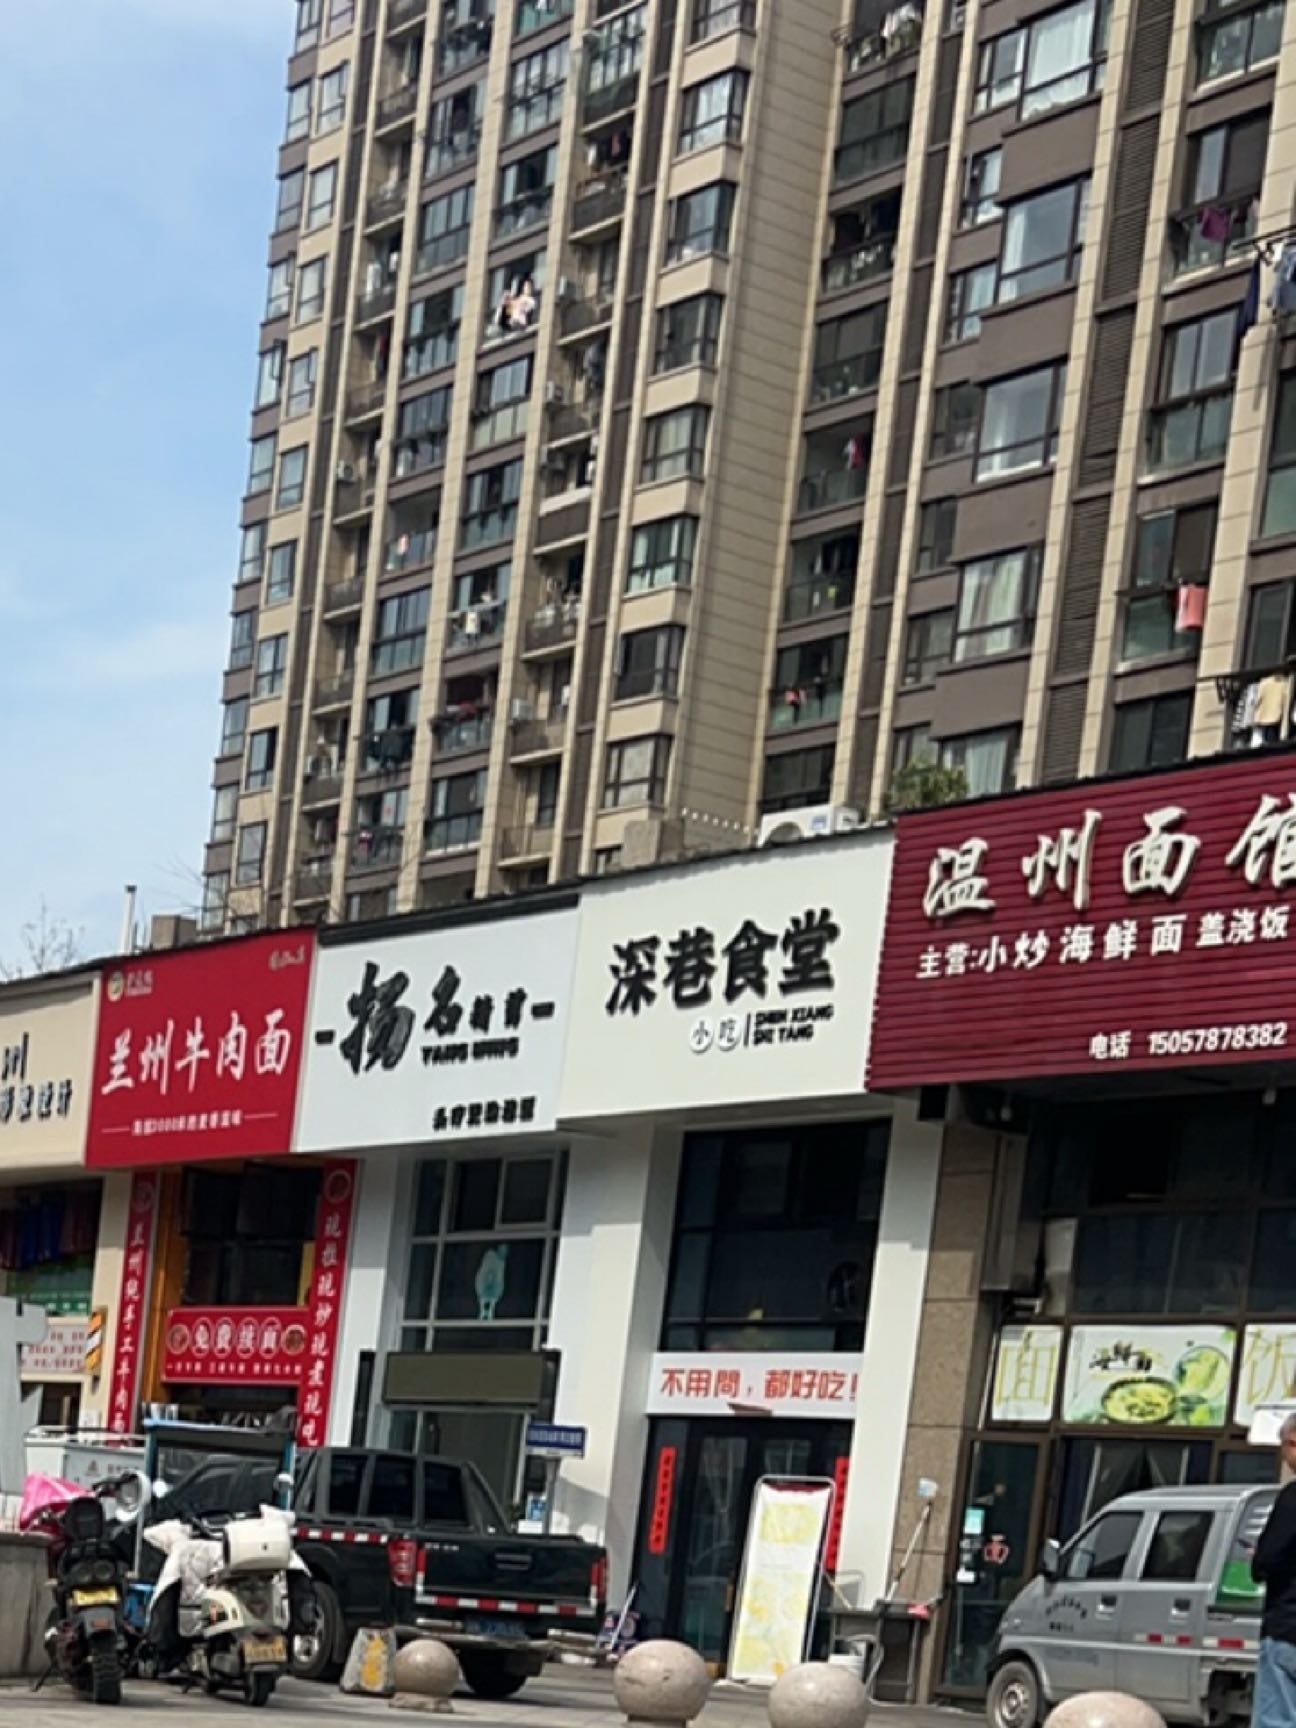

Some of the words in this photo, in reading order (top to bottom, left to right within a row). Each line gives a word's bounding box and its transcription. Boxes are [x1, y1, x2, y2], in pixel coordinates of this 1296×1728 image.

[923, 793, 1296, 918] 温州面馆
[606, 907, 840, 1016] 深巷食堂
[101, 1008, 291, 1095] 兰州牛肉面
[1089, 1031, 1131, 1059] 电话
[1147, 1022, 1288, 1056] 15057878382
